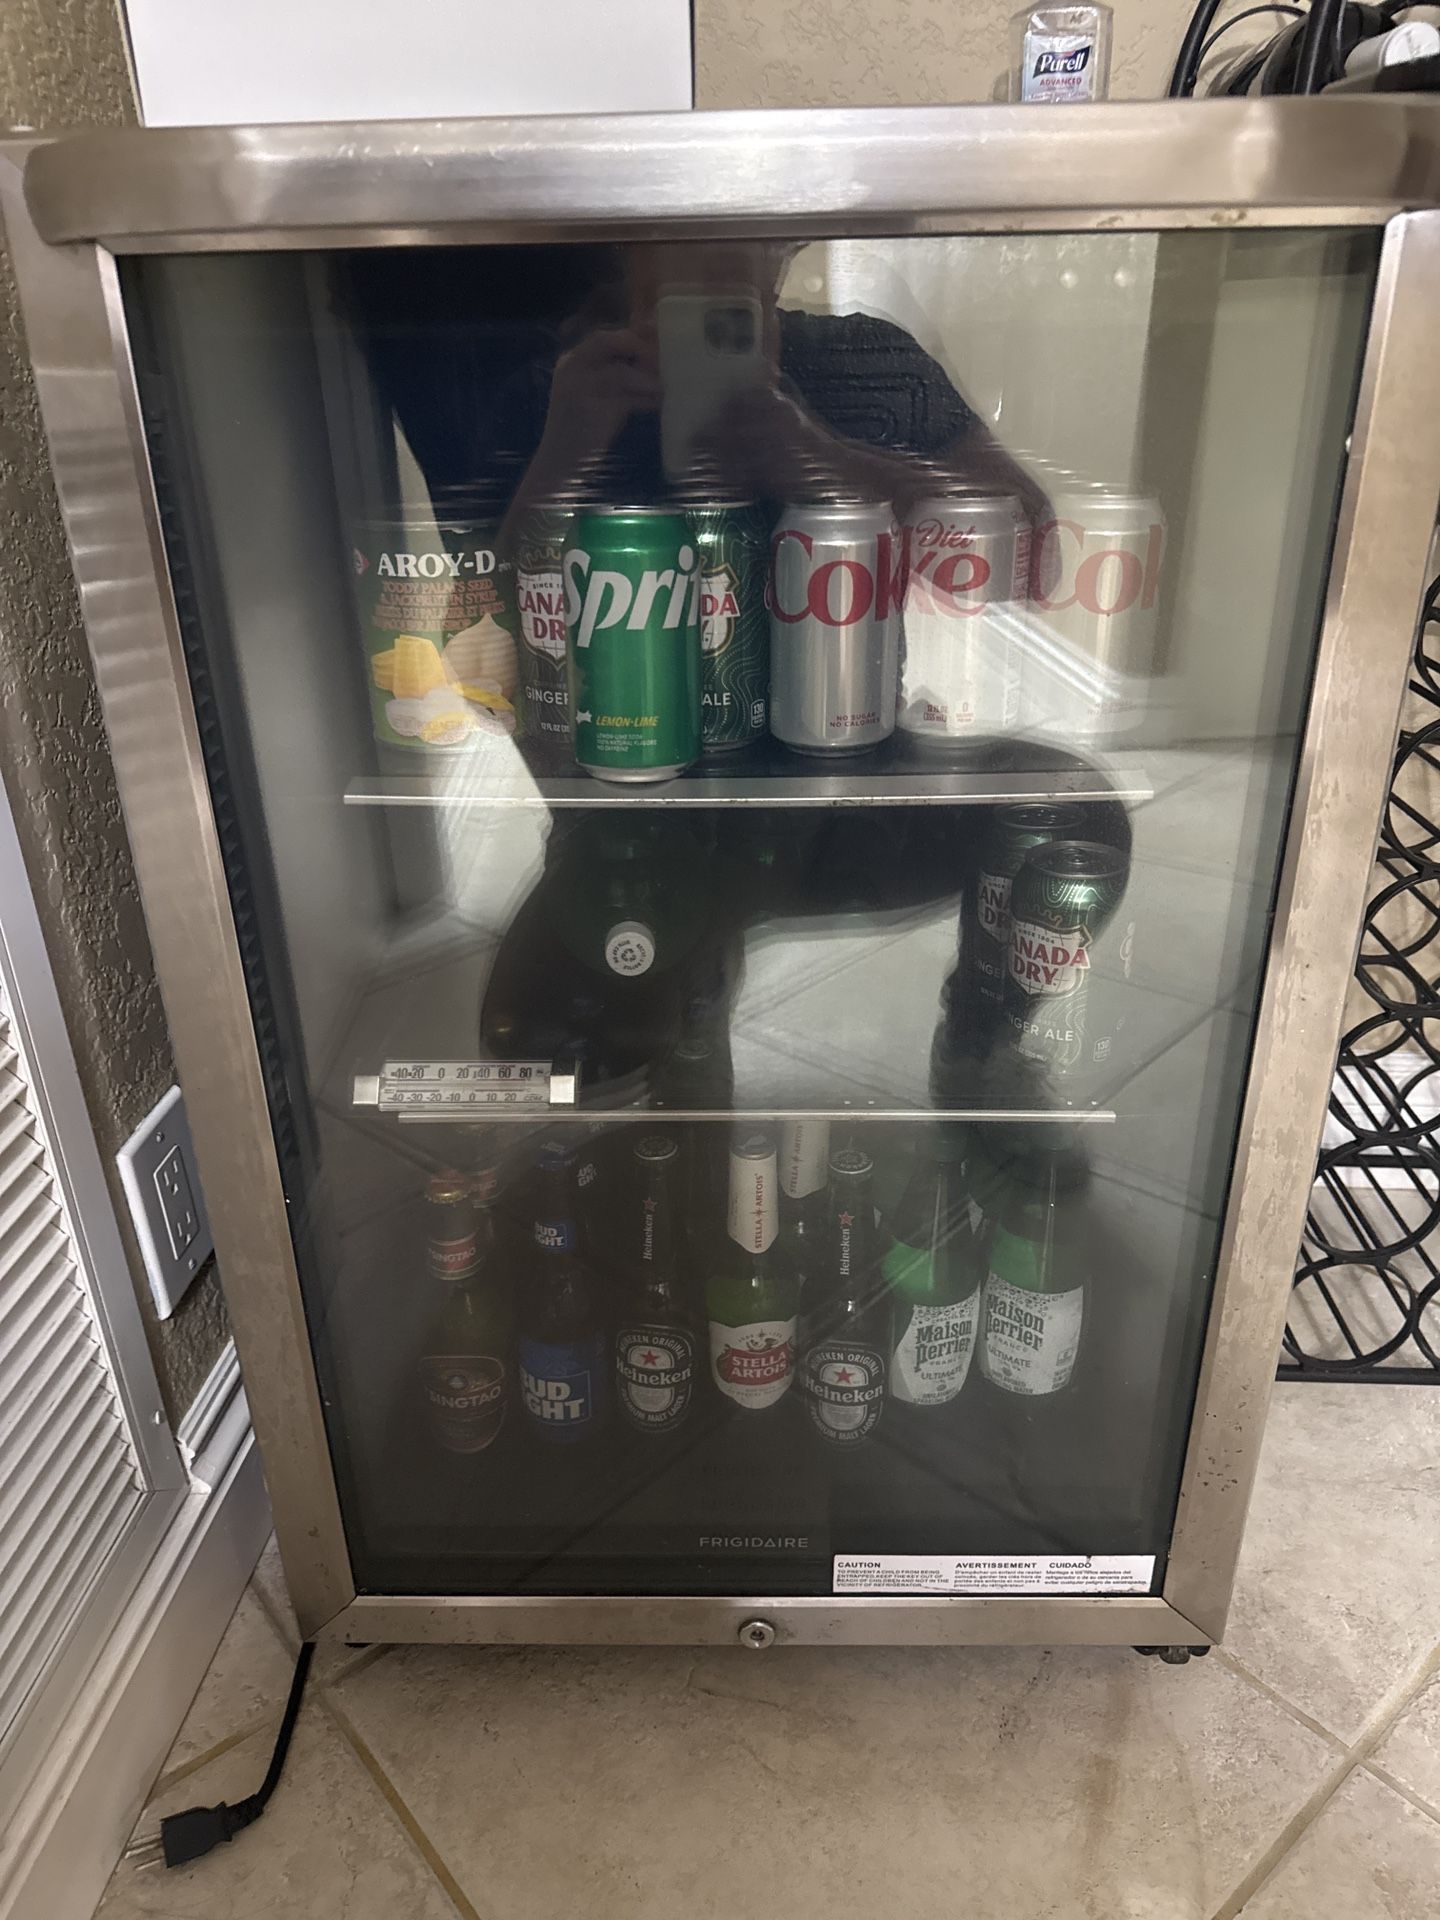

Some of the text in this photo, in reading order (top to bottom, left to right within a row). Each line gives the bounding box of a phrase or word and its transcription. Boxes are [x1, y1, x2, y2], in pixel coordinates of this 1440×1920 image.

[1040, 52, 1085, 72] Purell
[1040, 77, 1082, 87] ADVANCED
[915, 518, 978, 549] Diet
[377, 549, 496, 577] AROY-D
[702, 692, 731, 706] ALE
[829, 721, 842, 729] NO
[836, 711, 876, 722] NO SUGAR
[1044, 1030, 1074, 1044] ALE
[438, 1067, 445, 1079] 0
[456, 1067, 469, 1079] 20
[498, 1067, 511, 1079] 60
[519, 1067, 532, 1079] 80
[406, 1093, 423, 1102] -30
[426, 1093, 441, 1102] -20
[445, 1093, 460, 1102] -10
[469, 1093, 476, 1102] 0
[486, 1093, 496, 1102] 10
[504, 1093, 517, 1102] 20
[755, 1174, 764, 1249] STELLA ARTOIS
[643, 1214, 653, 1260] Heineken
[839, 1228, 850, 1276] Heineken
[915, 1320, 972, 1344] Maison
[732, 1351, 786, 1368] STELLA
[616, 1356, 691, 1385] Heineken
[732, 1360, 786, 1379] ARTOIS
[805, 1375, 883, 1403] Heineken
[699, 1536, 809, 1548] FRIGIDAIRE
